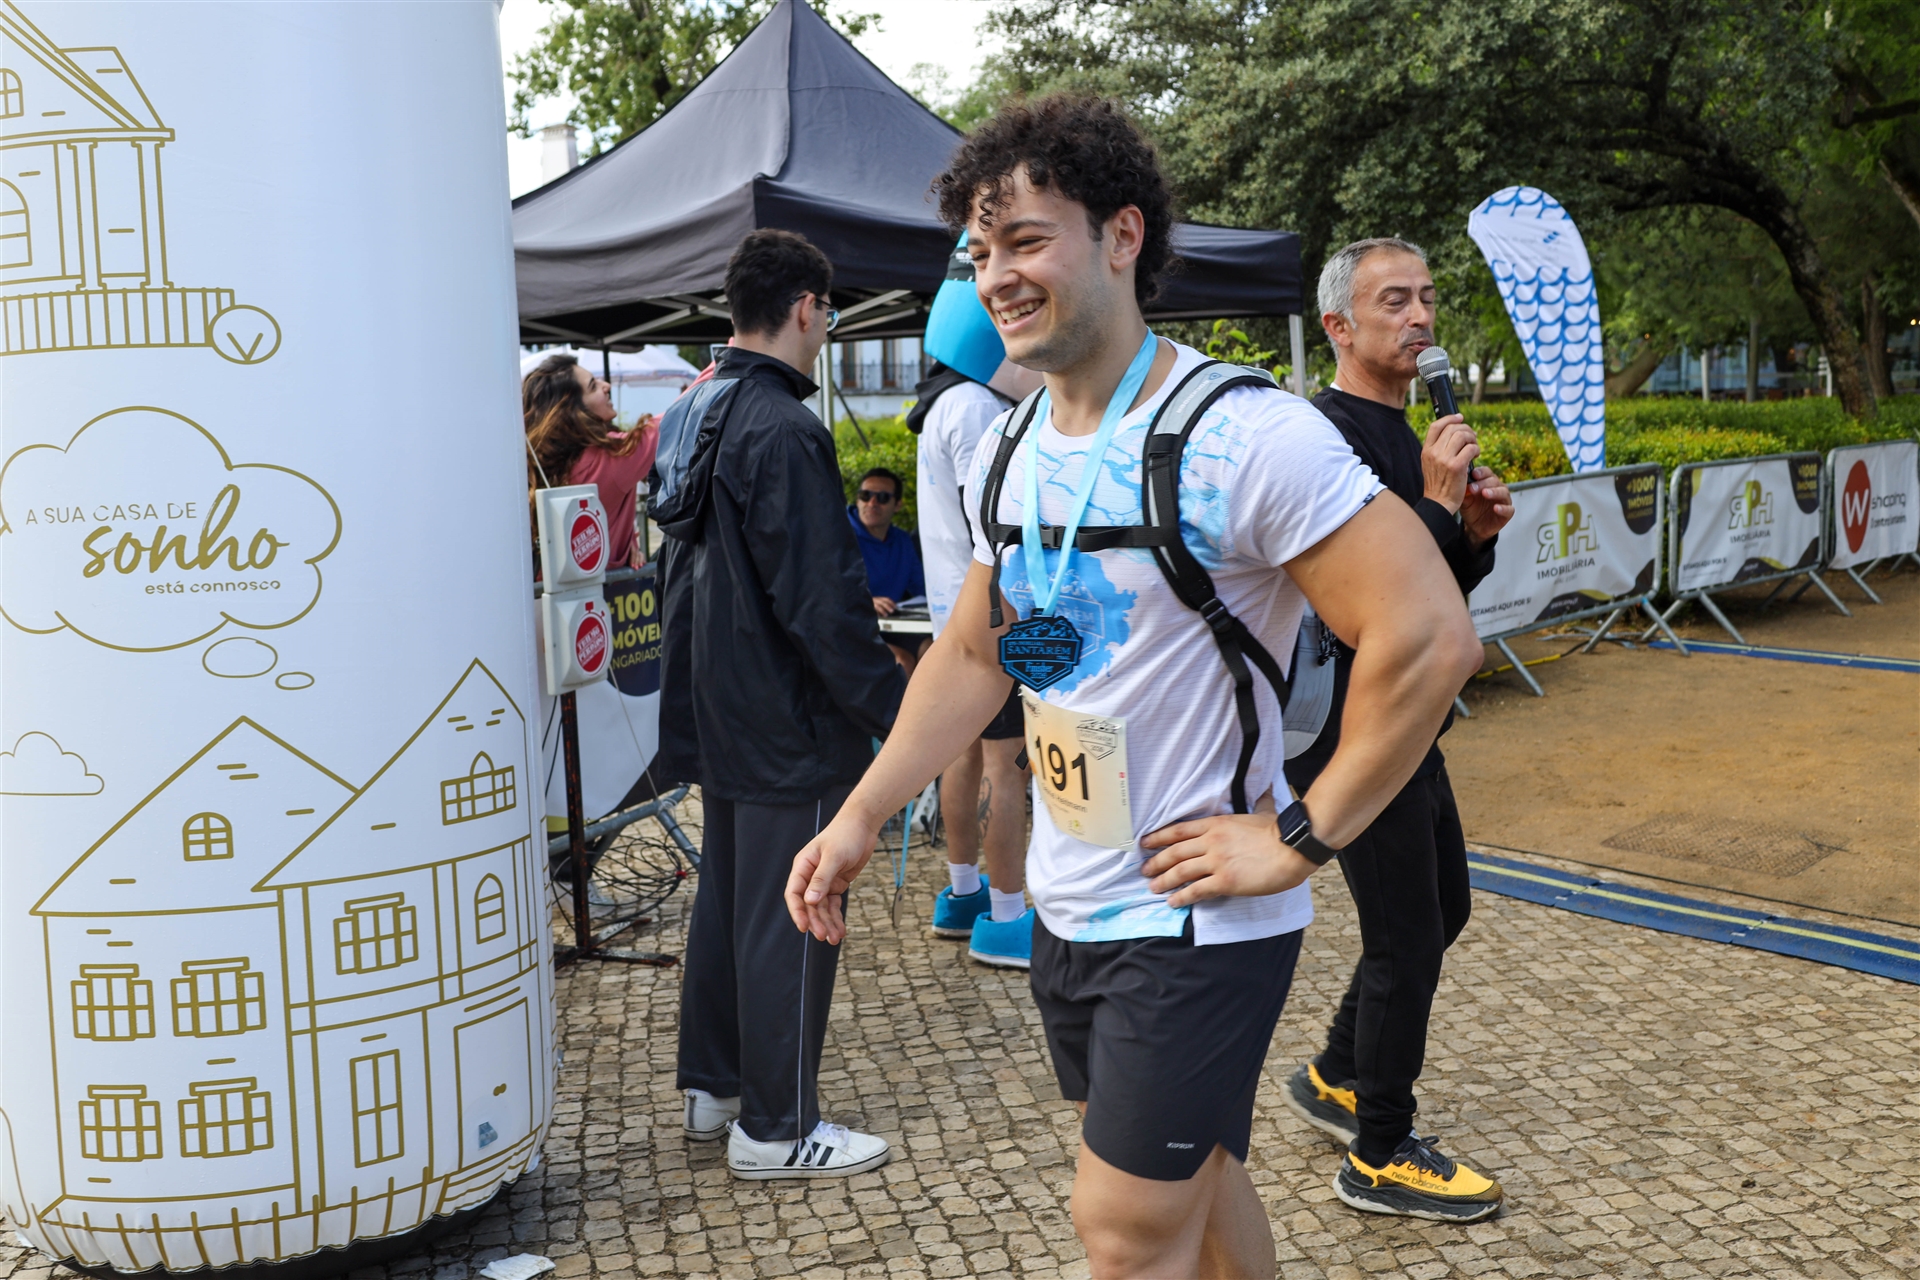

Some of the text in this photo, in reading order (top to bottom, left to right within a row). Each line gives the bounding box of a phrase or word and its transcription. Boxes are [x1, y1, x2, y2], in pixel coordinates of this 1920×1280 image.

[26, 502, 198, 525] A SUA CASA DE
[1845, 488, 1870, 528] W
[83, 483, 290, 578] sonho
[1537, 557, 1595, 580] IMOBILIÁRIA
[144, 580, 281, 595] está connosco
[607, 589, 655, 623] +100
[1007, 644, 1071, 655] SANTARÉM
[1035, 735, 1089, 800] 191
[1391, 1171, 1449, 1192] new balance
